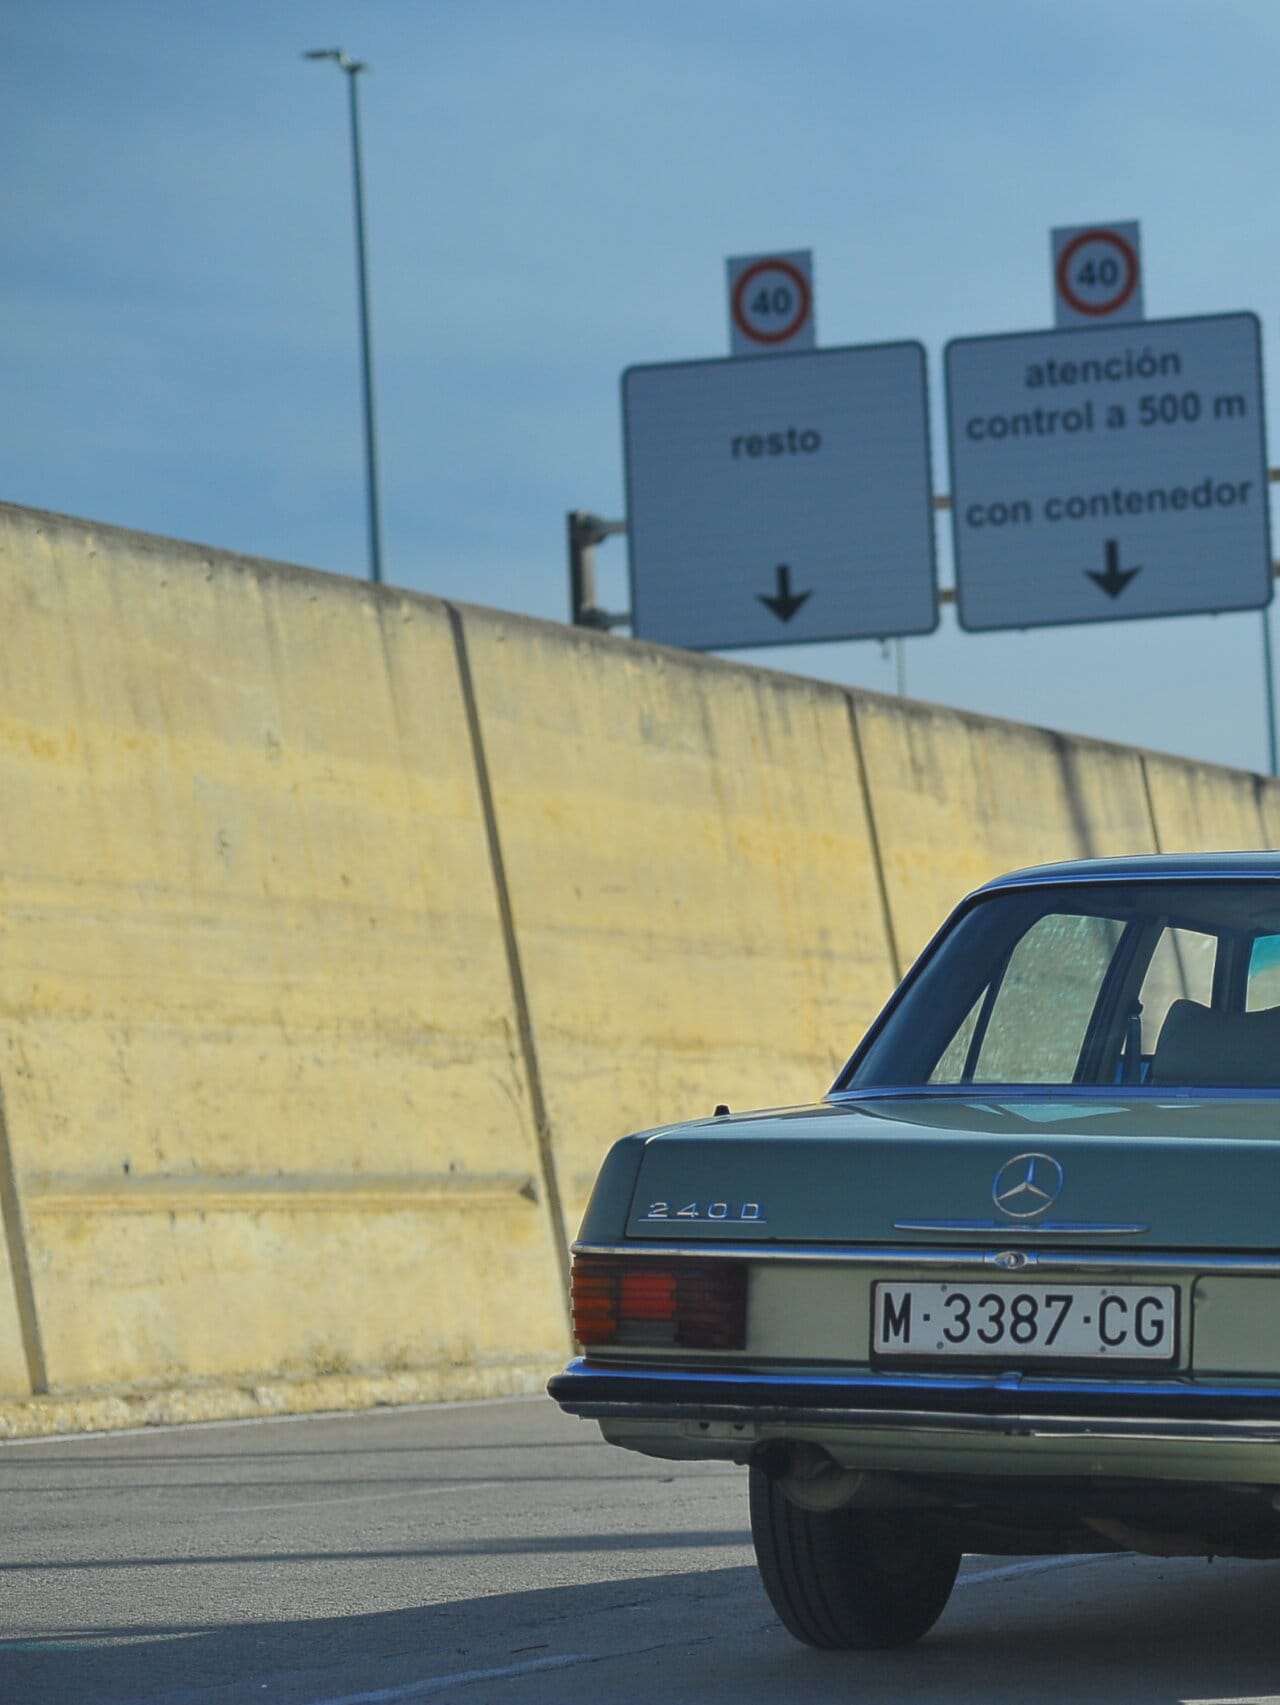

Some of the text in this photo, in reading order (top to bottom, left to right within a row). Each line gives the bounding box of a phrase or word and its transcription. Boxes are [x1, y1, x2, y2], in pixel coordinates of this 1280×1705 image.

[1077, 257, 1119, 288] 40
[751, 287, 793, 317] 40
[1025, 347, 1181, 388] atención
[965, 391, 1246, 441] control a 500 m
[731, 426, 822, 459] resto
[965, 477, 1253, 528] con contenedor
